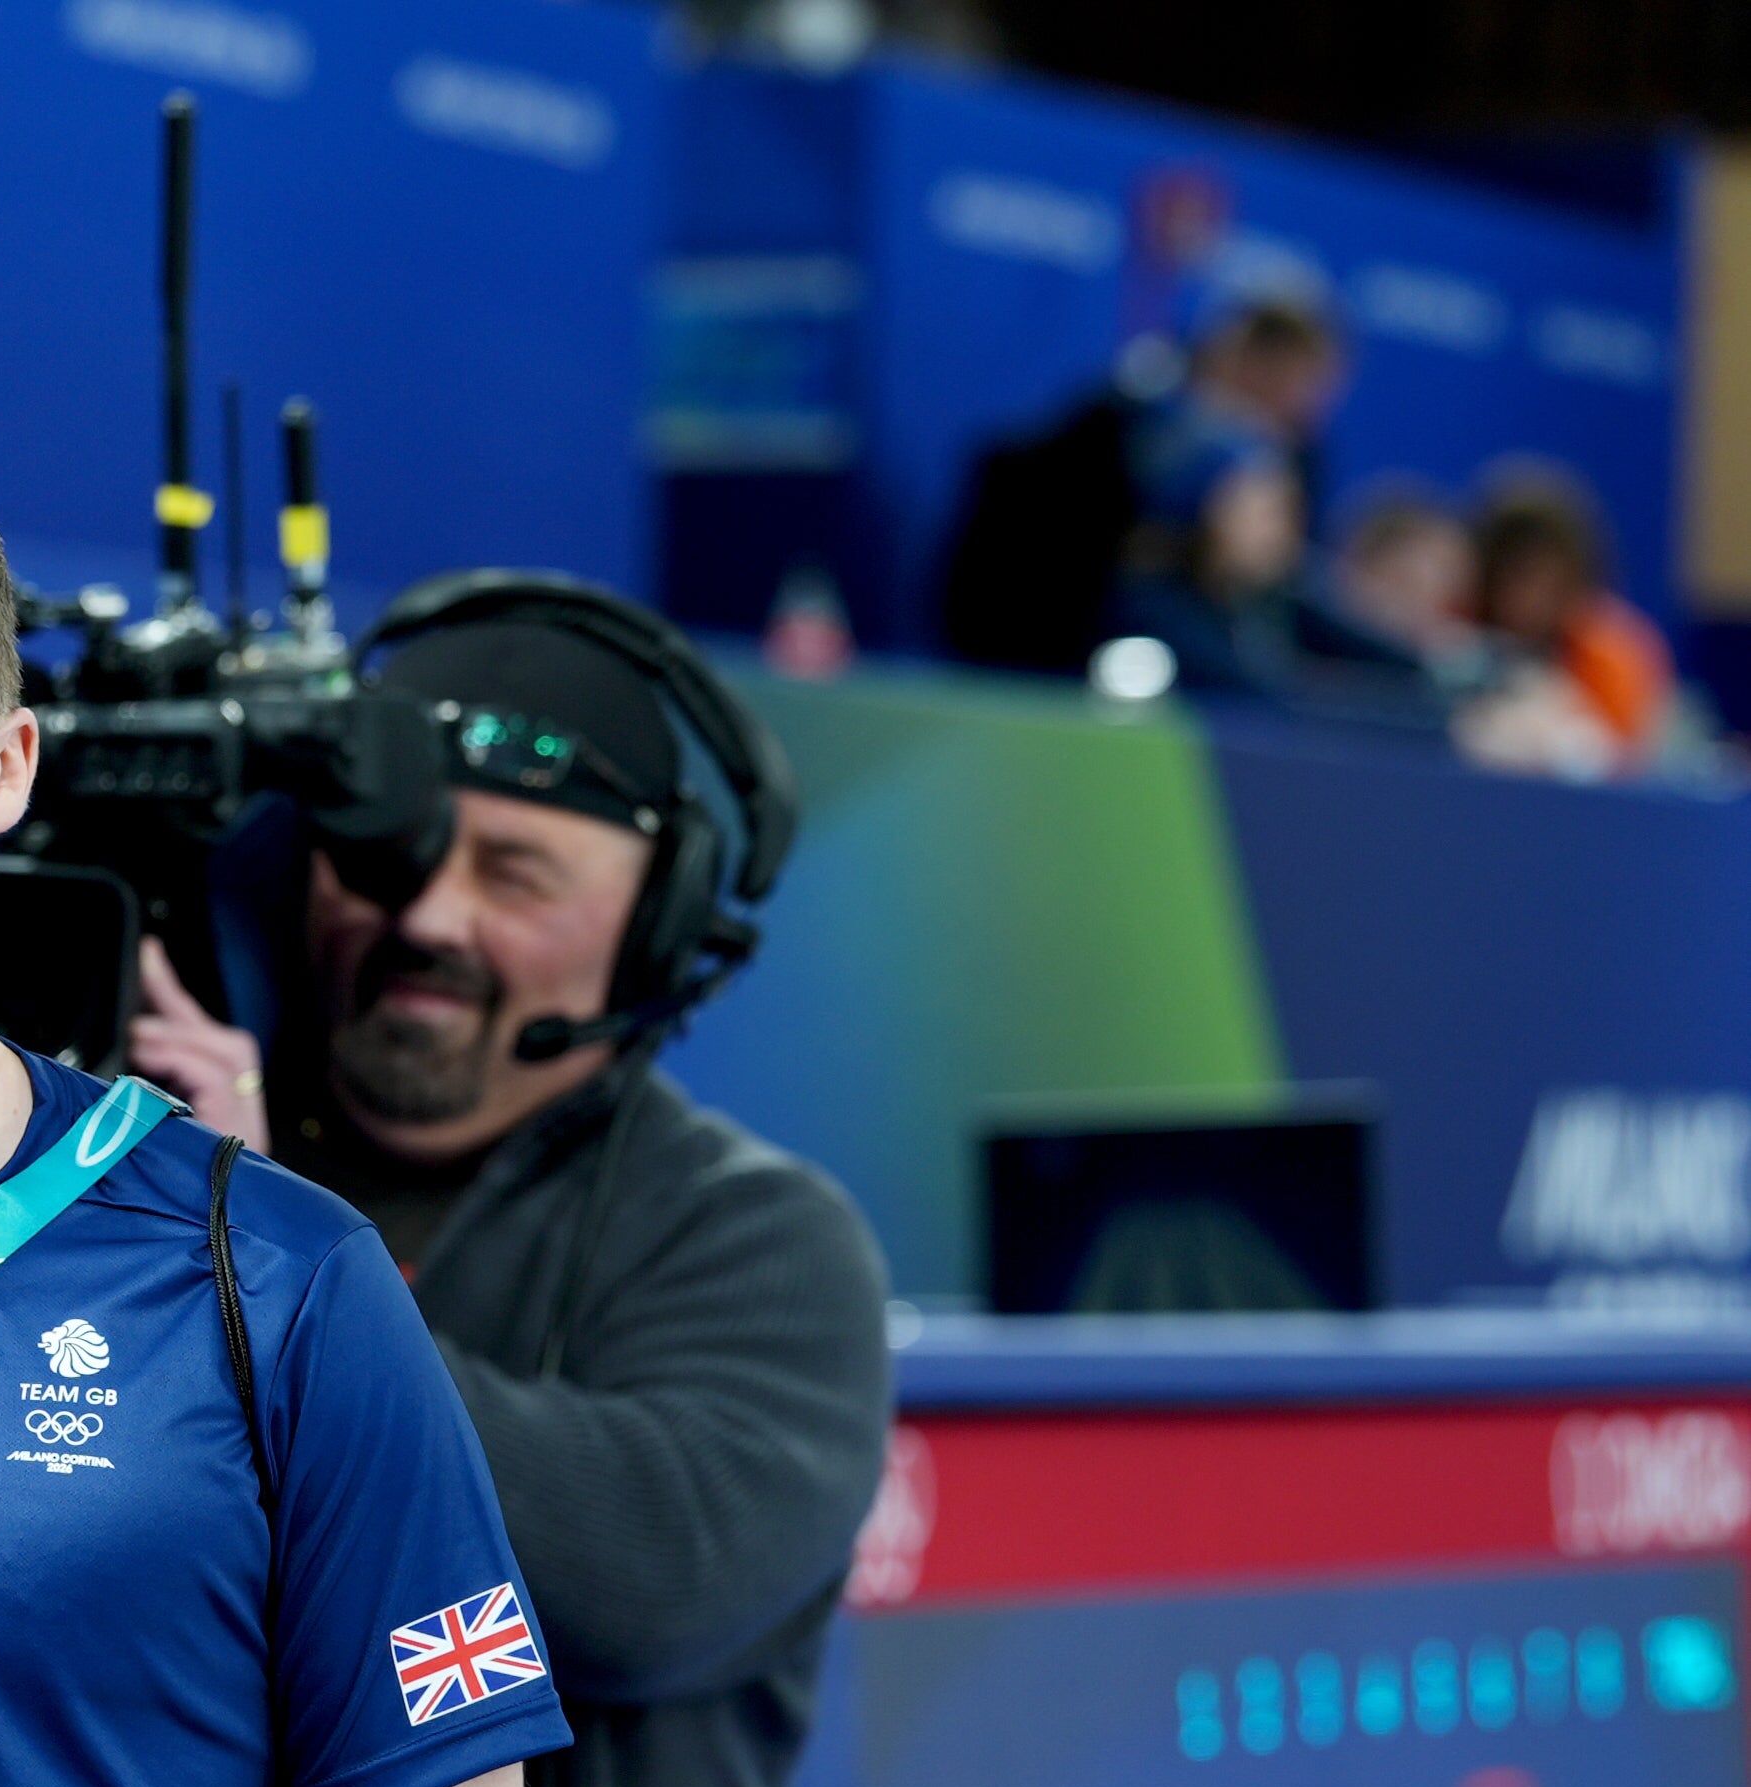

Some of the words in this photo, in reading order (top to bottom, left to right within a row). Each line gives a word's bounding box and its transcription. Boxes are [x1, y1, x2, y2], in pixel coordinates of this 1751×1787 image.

[20, 1383, 79, 1403] TEAM
[85, 1387, 118, 1406] GB
[6, 1450, 60, 1463] MILANO
[61, 1453, 115, 1469] CORTINA
[46, 1463, 74, 1474] 2026
